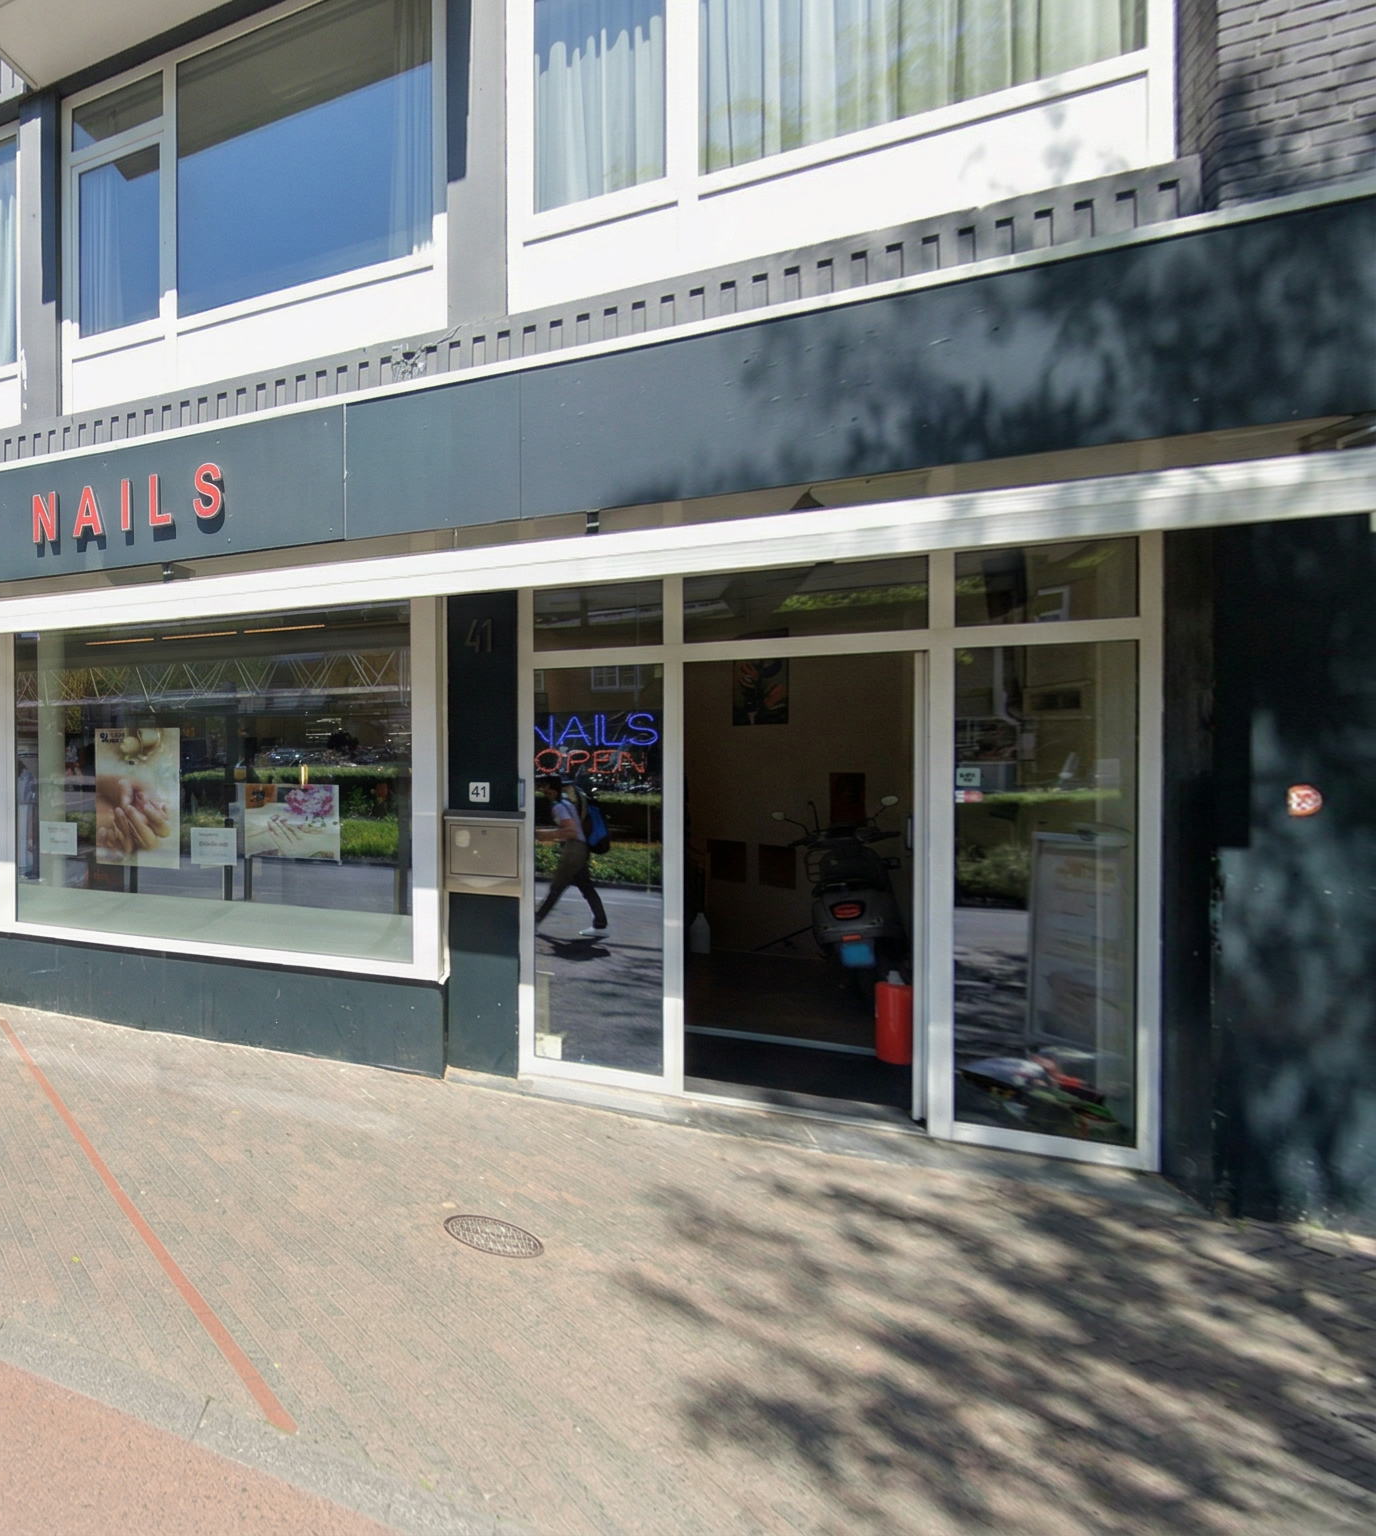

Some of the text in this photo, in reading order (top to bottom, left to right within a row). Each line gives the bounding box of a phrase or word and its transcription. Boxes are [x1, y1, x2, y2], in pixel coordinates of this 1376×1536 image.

[32, 462, 223, 542] NAILS
[464, 617, 493, 654] 41
[534, 713, 659, 748] NAILS
[535, 748, 645, 774] OPEN
[471, 785, 487, 798] 41
